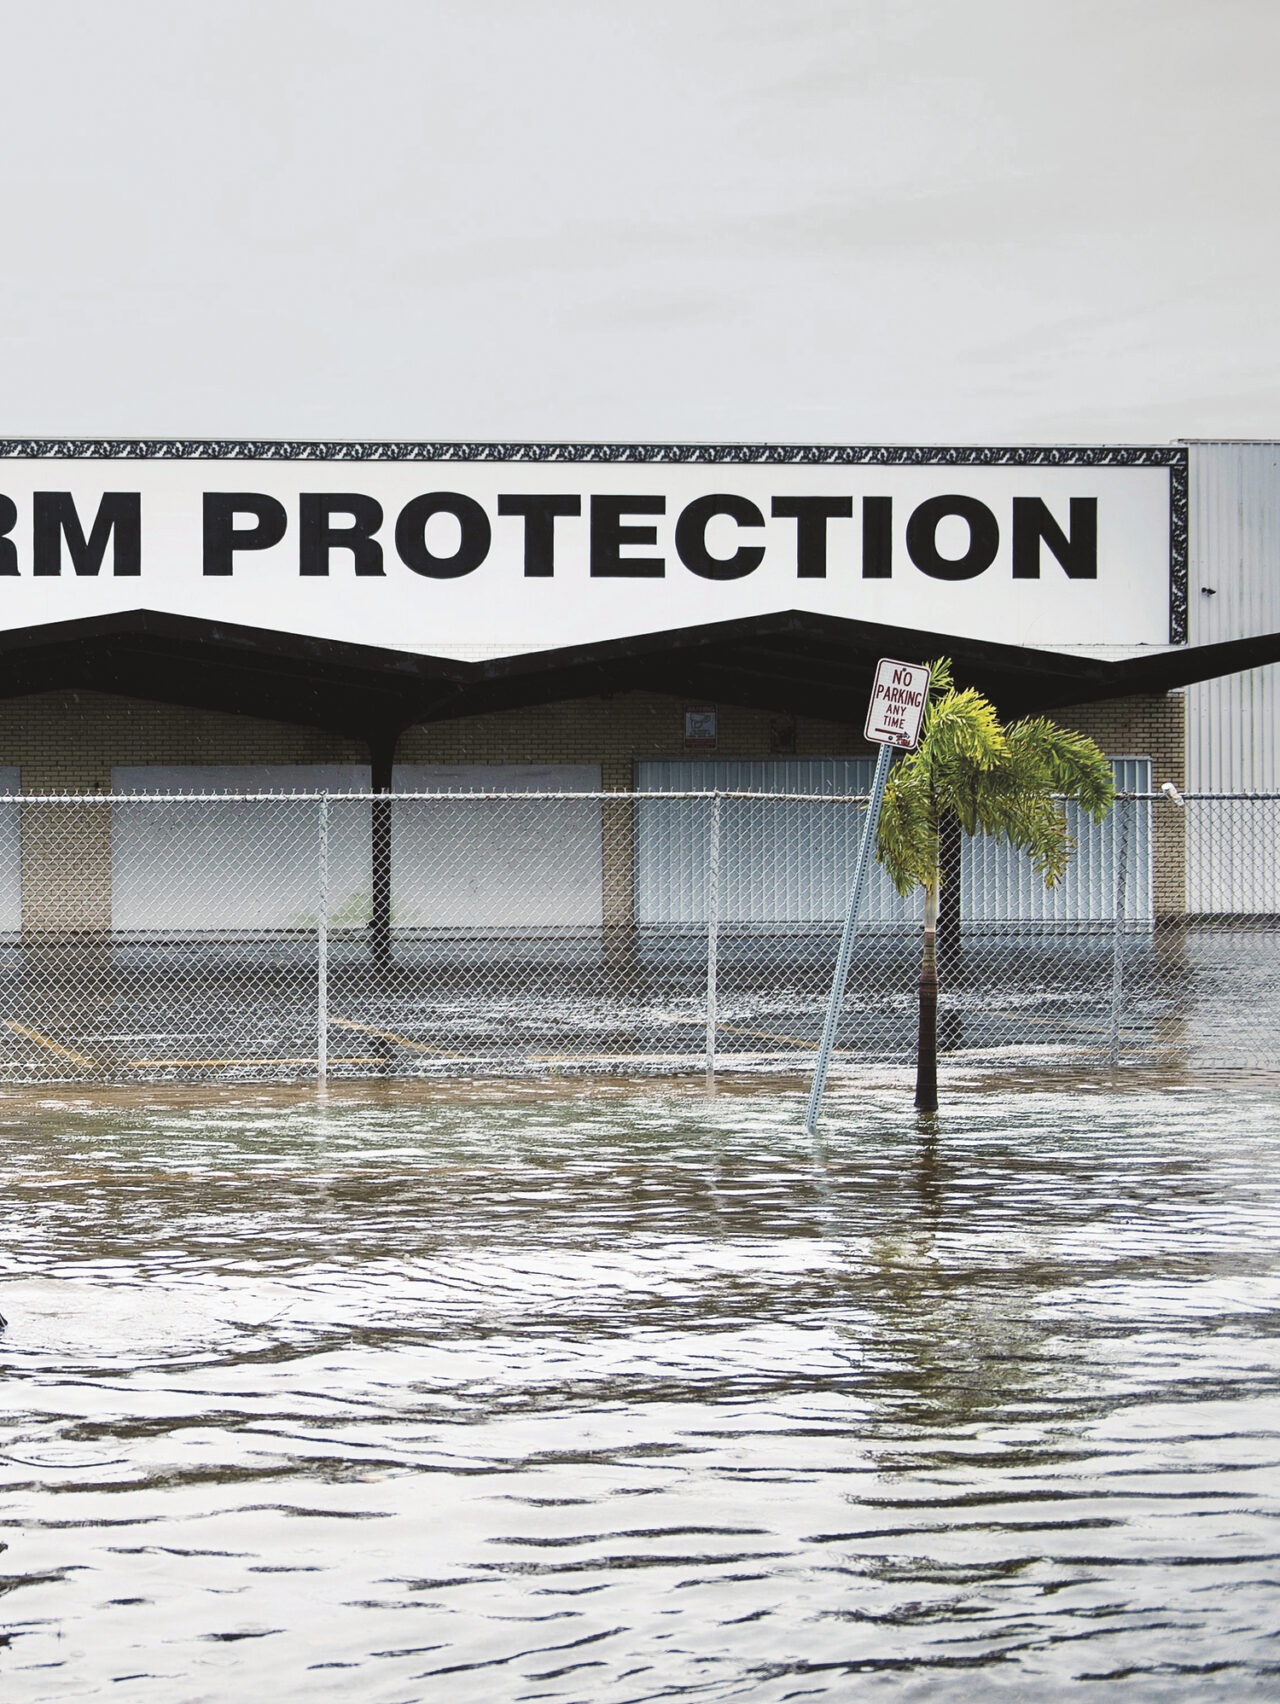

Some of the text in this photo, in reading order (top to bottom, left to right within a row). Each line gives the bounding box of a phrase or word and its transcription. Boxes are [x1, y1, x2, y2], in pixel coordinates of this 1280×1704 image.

[202, 491, 1098, 582] PROTECTION
[892, 668, 913, 687] NO
[876, 684, 922, 708] PARKING
[885, 703, 907, 717] ANY
[883, 715, 905, 730] TIME
